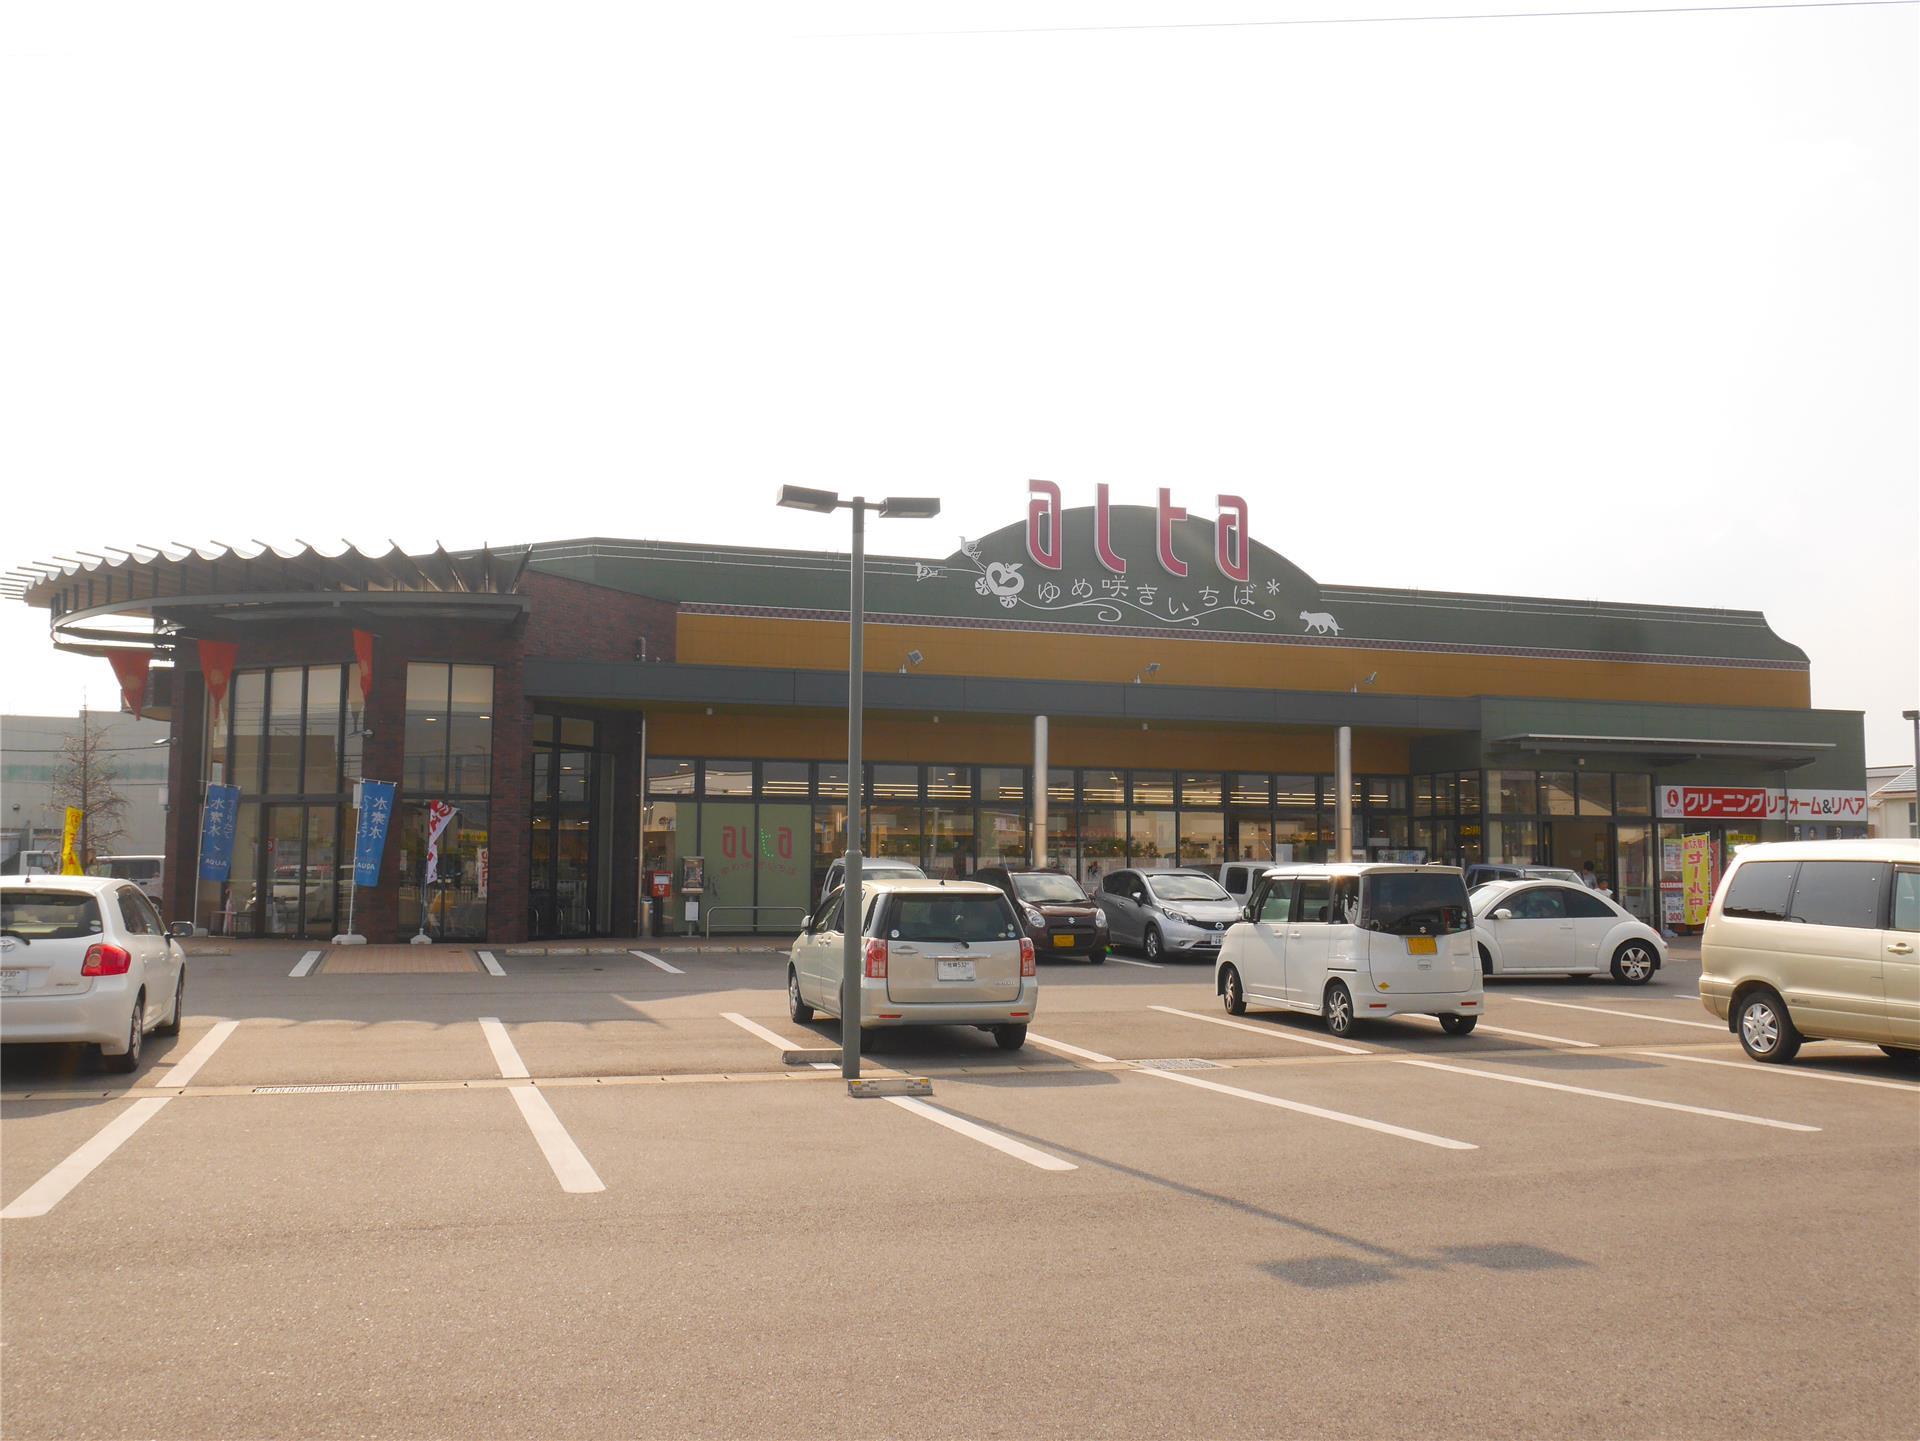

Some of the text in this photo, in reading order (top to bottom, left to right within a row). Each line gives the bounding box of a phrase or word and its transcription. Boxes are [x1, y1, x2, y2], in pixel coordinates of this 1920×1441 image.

[1025, 479, 1250, 582] alta
[1037, 577, 1257, 615] ゆめ咲きいちば
[209, 797, 225, 837] 水素水
[1685, 793, 1764, 813] クリーニング
